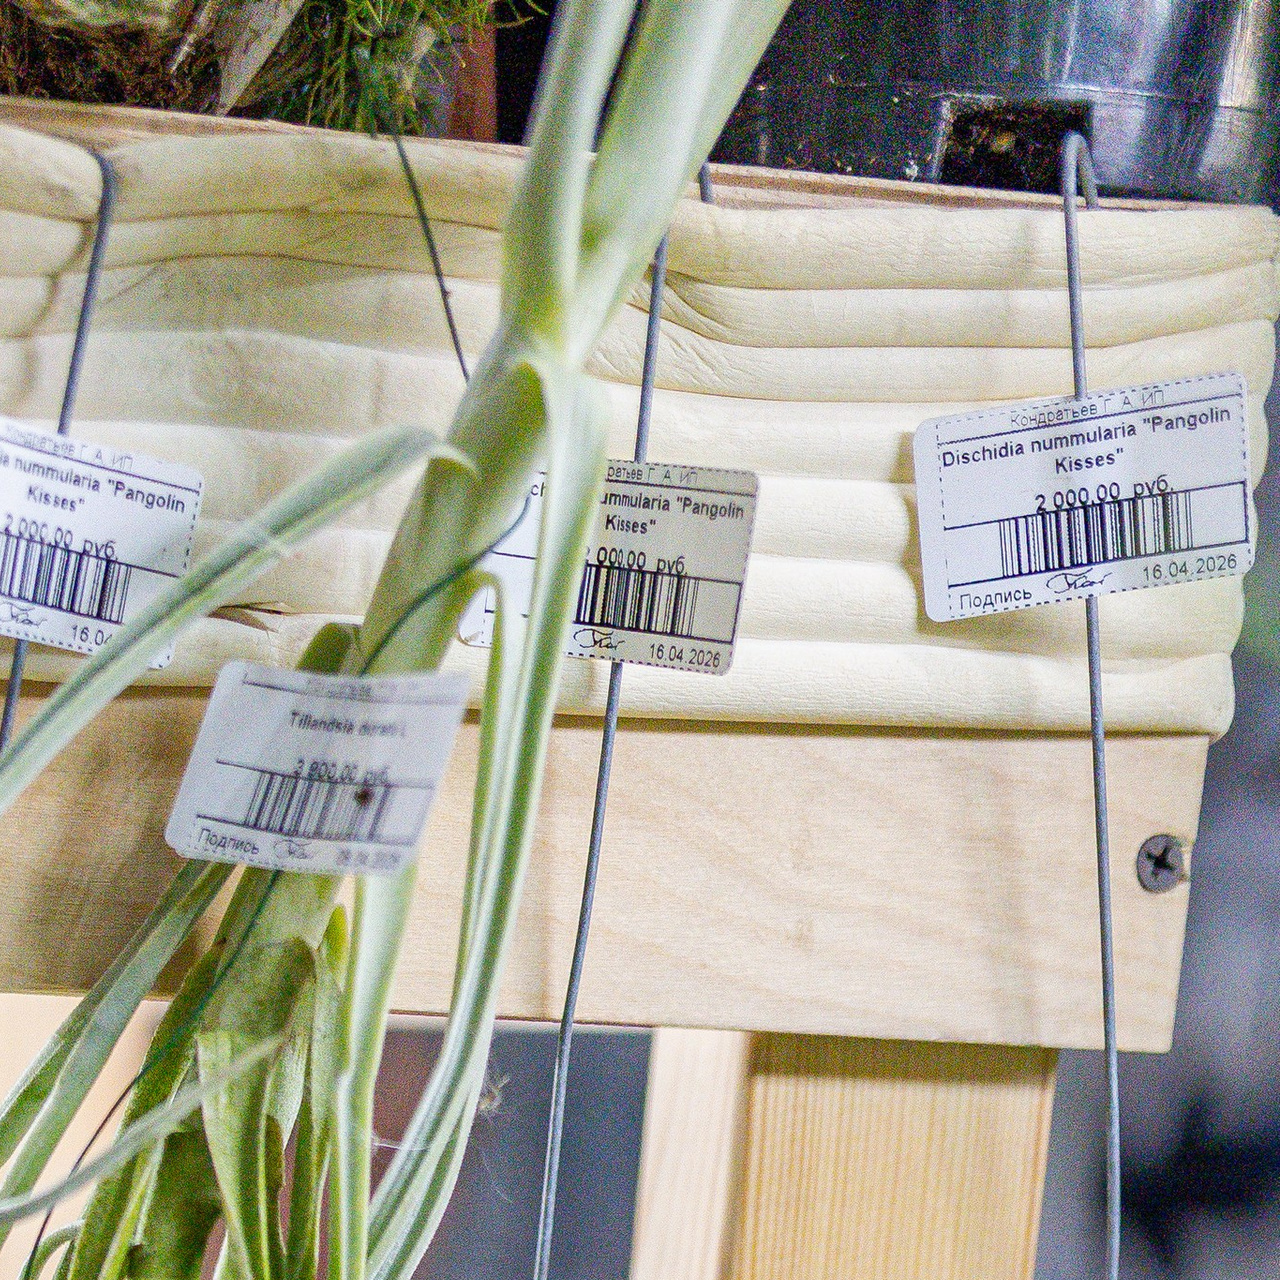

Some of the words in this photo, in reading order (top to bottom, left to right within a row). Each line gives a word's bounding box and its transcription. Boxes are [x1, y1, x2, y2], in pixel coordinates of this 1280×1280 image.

[1011, 402, 1098, 428] Кондратьев
[1141, 390, 1166, 407] ИП
[942, 442, 1025, 468] Dischidia
[1031, 422, 1137, 455] nummularia
[1143, 407, 1231, 433] "Pangolin
[1055, 447, 1124, 475] Kisses"
[14, 455, 101, 492] nummularia
[108, 479, 186, 514] "Pangolin
[27, 485, 85, 513] Kisses"
[677, 496, 744, 520] "Pangolin
[605, 514, 656, 534] Kisses"
[959, 588, 1033, 611] Подпись
[1143, 555, 1238, 582] 16.04.2026
[649, 643, 721, 668] 16.04.2026
[197, 827, 260, 855] Подпись
